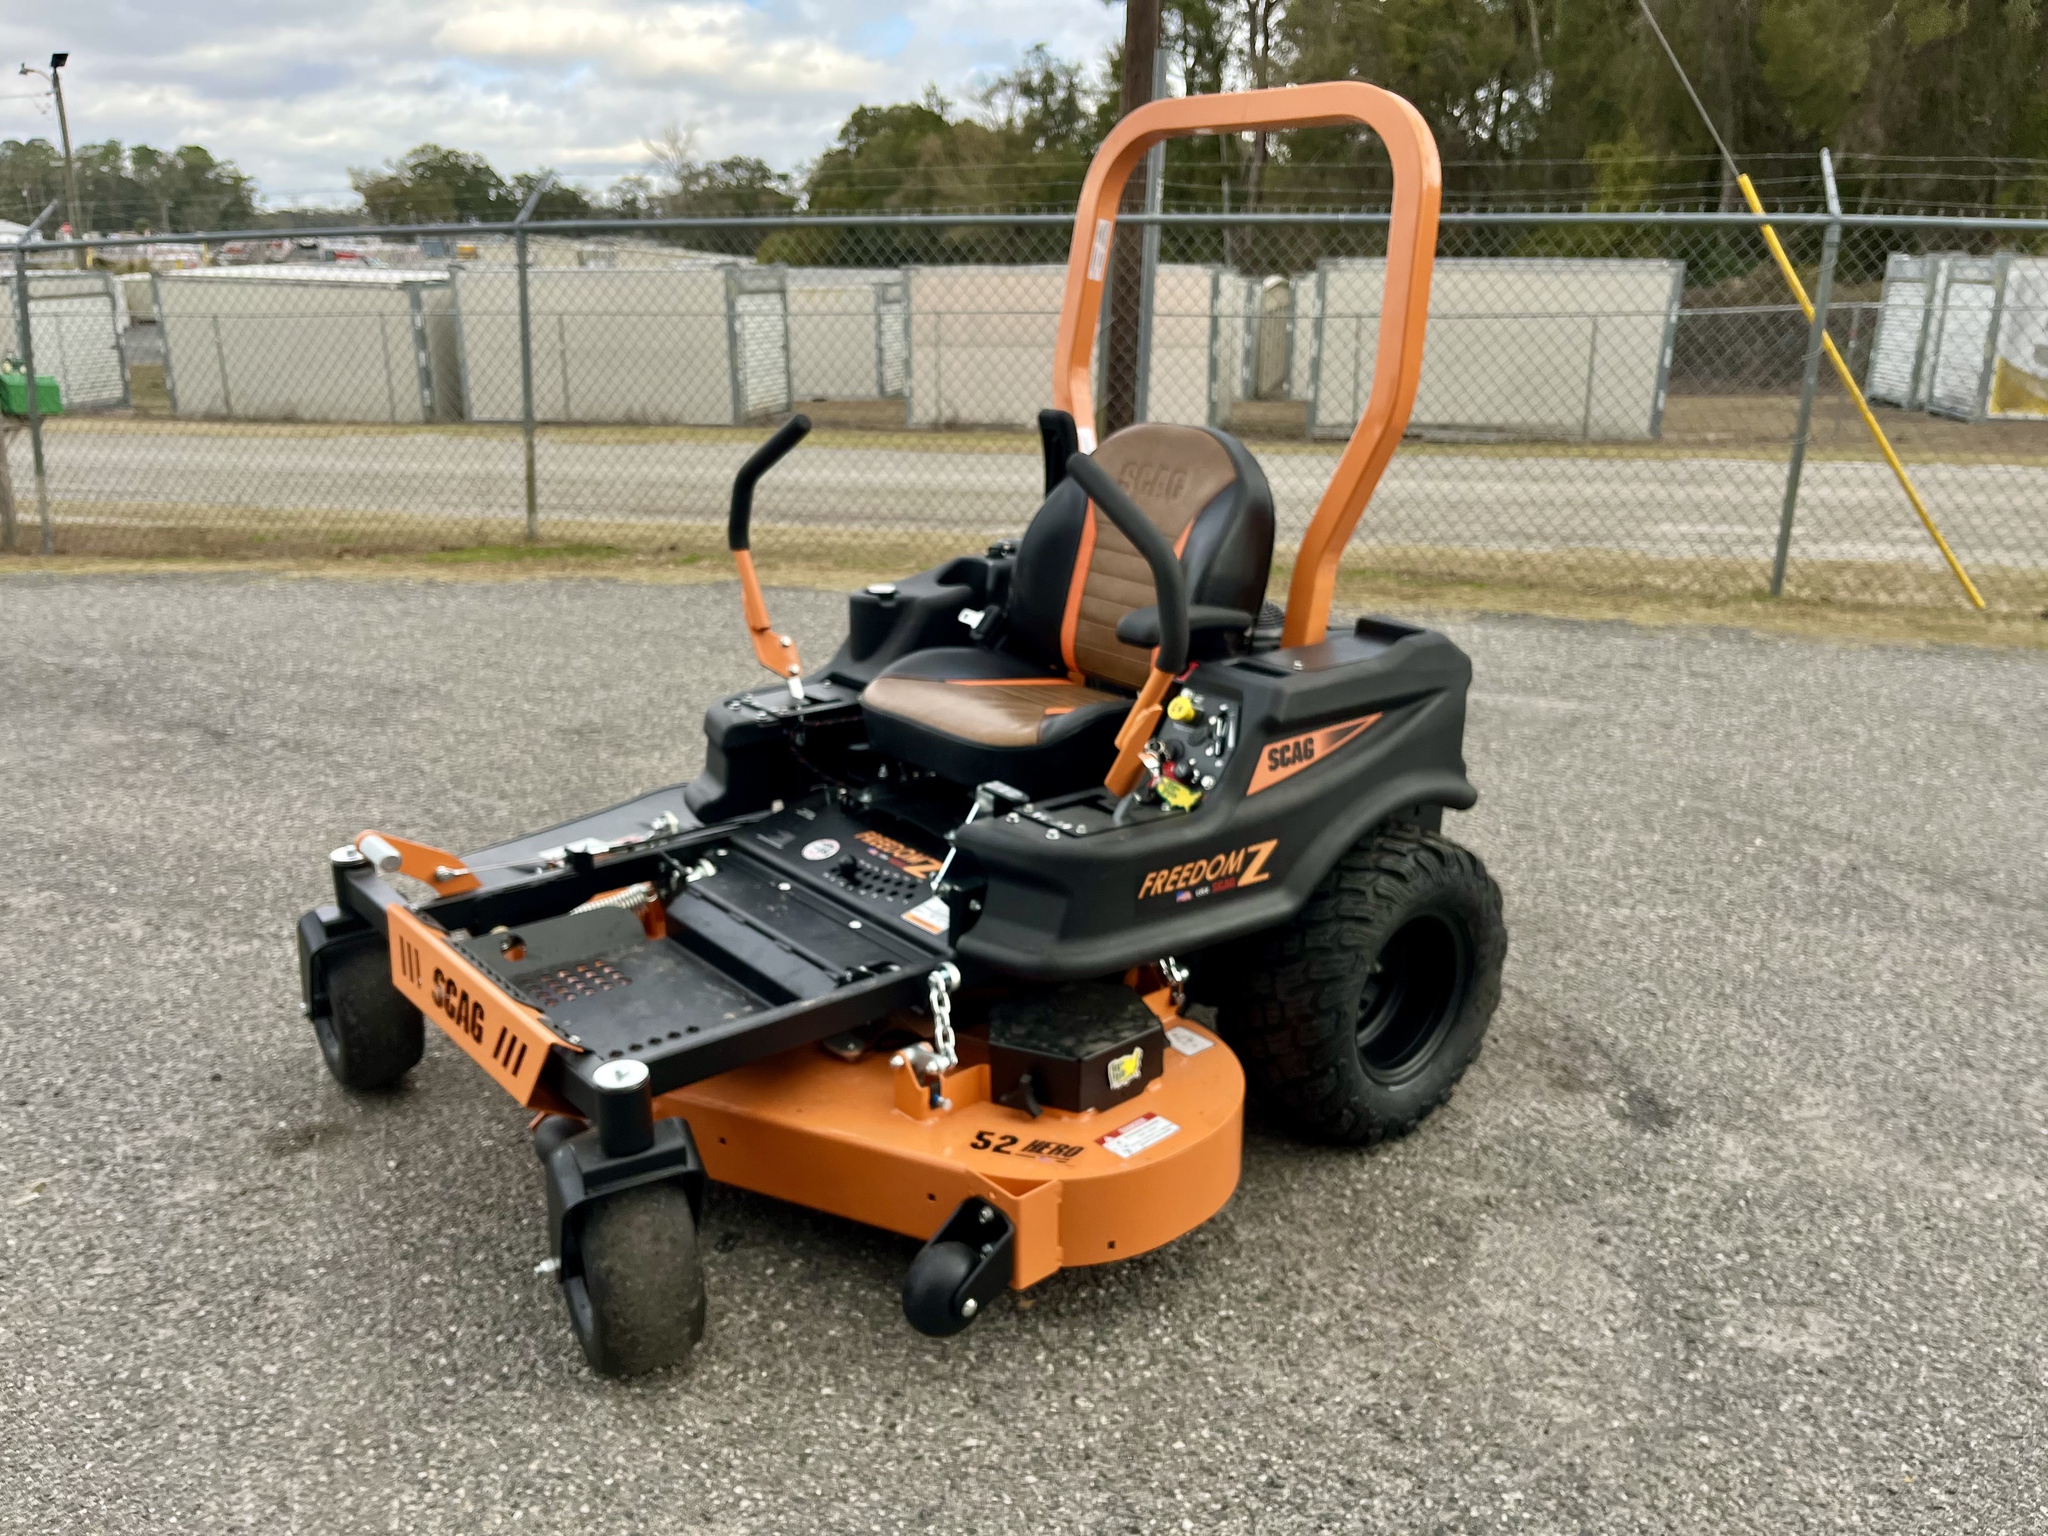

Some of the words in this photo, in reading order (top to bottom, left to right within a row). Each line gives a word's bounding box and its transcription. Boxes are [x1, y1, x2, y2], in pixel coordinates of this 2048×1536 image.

[1267, 736, 1316, 772] SCAG
[431, 966, 485, 1045] SCAG
[970, 1130, 1019, 1155] 52
[1021, 1139, 1085, 1158] HERO
